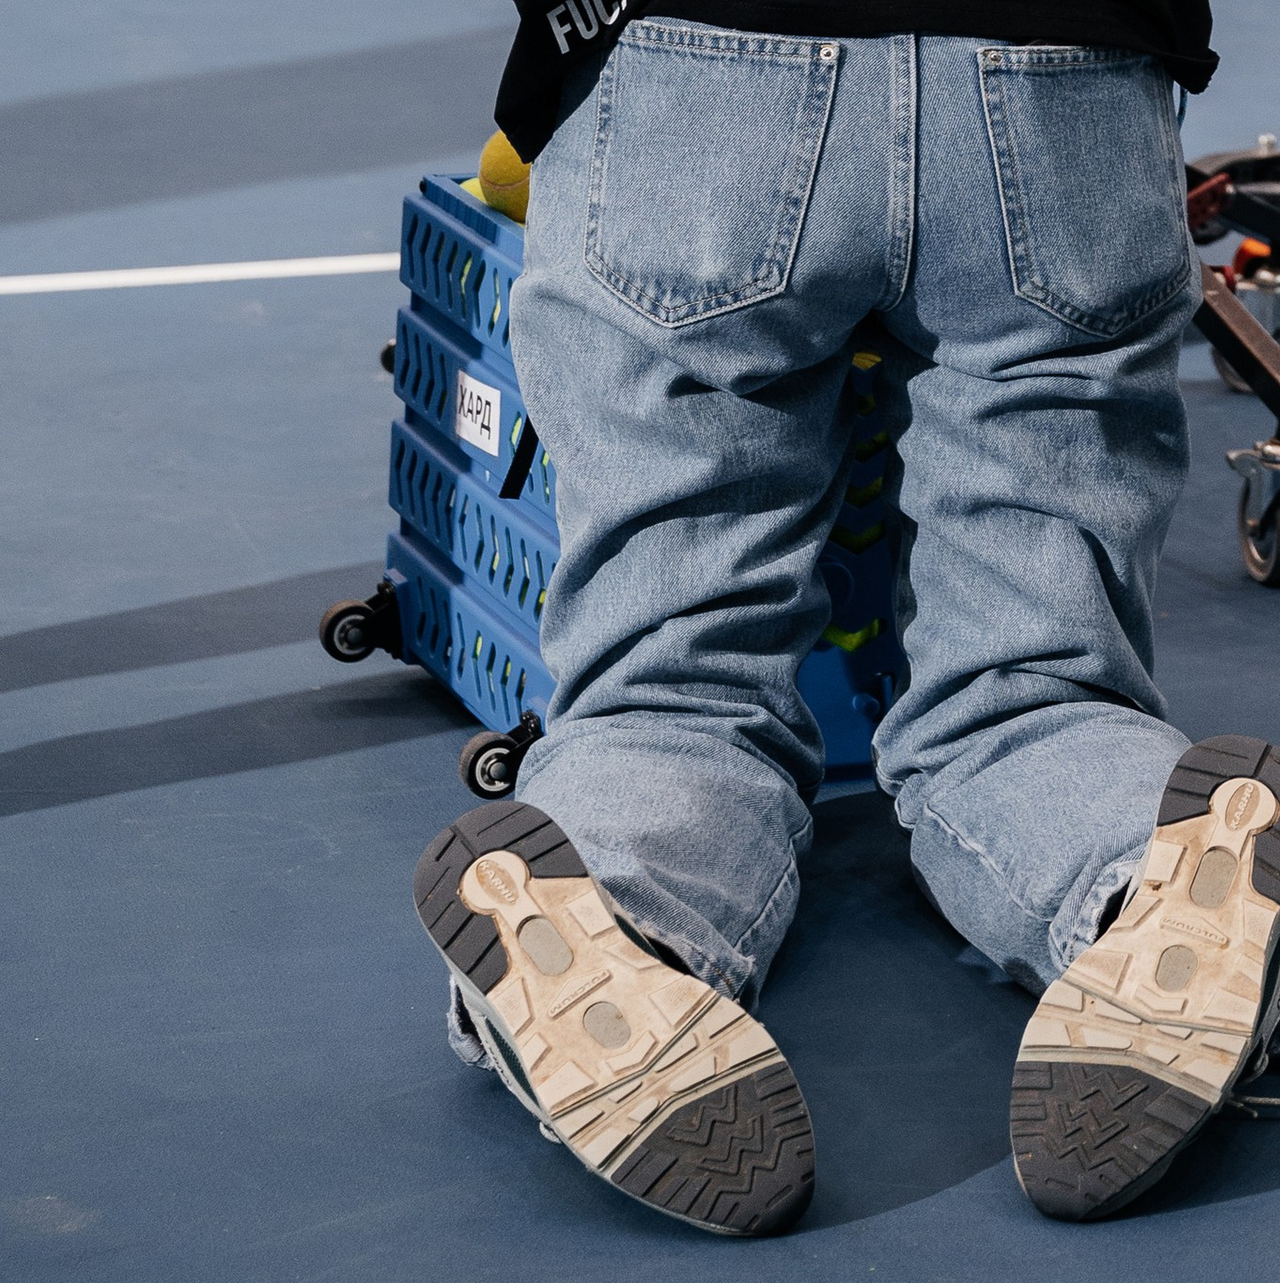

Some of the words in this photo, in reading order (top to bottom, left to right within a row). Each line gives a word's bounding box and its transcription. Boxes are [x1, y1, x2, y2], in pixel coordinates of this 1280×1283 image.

[458, 384, 491, 440] ХАРД
[1230, 783, 1255, 830] KARHU
[479, 860, 517, 906] KARHU
